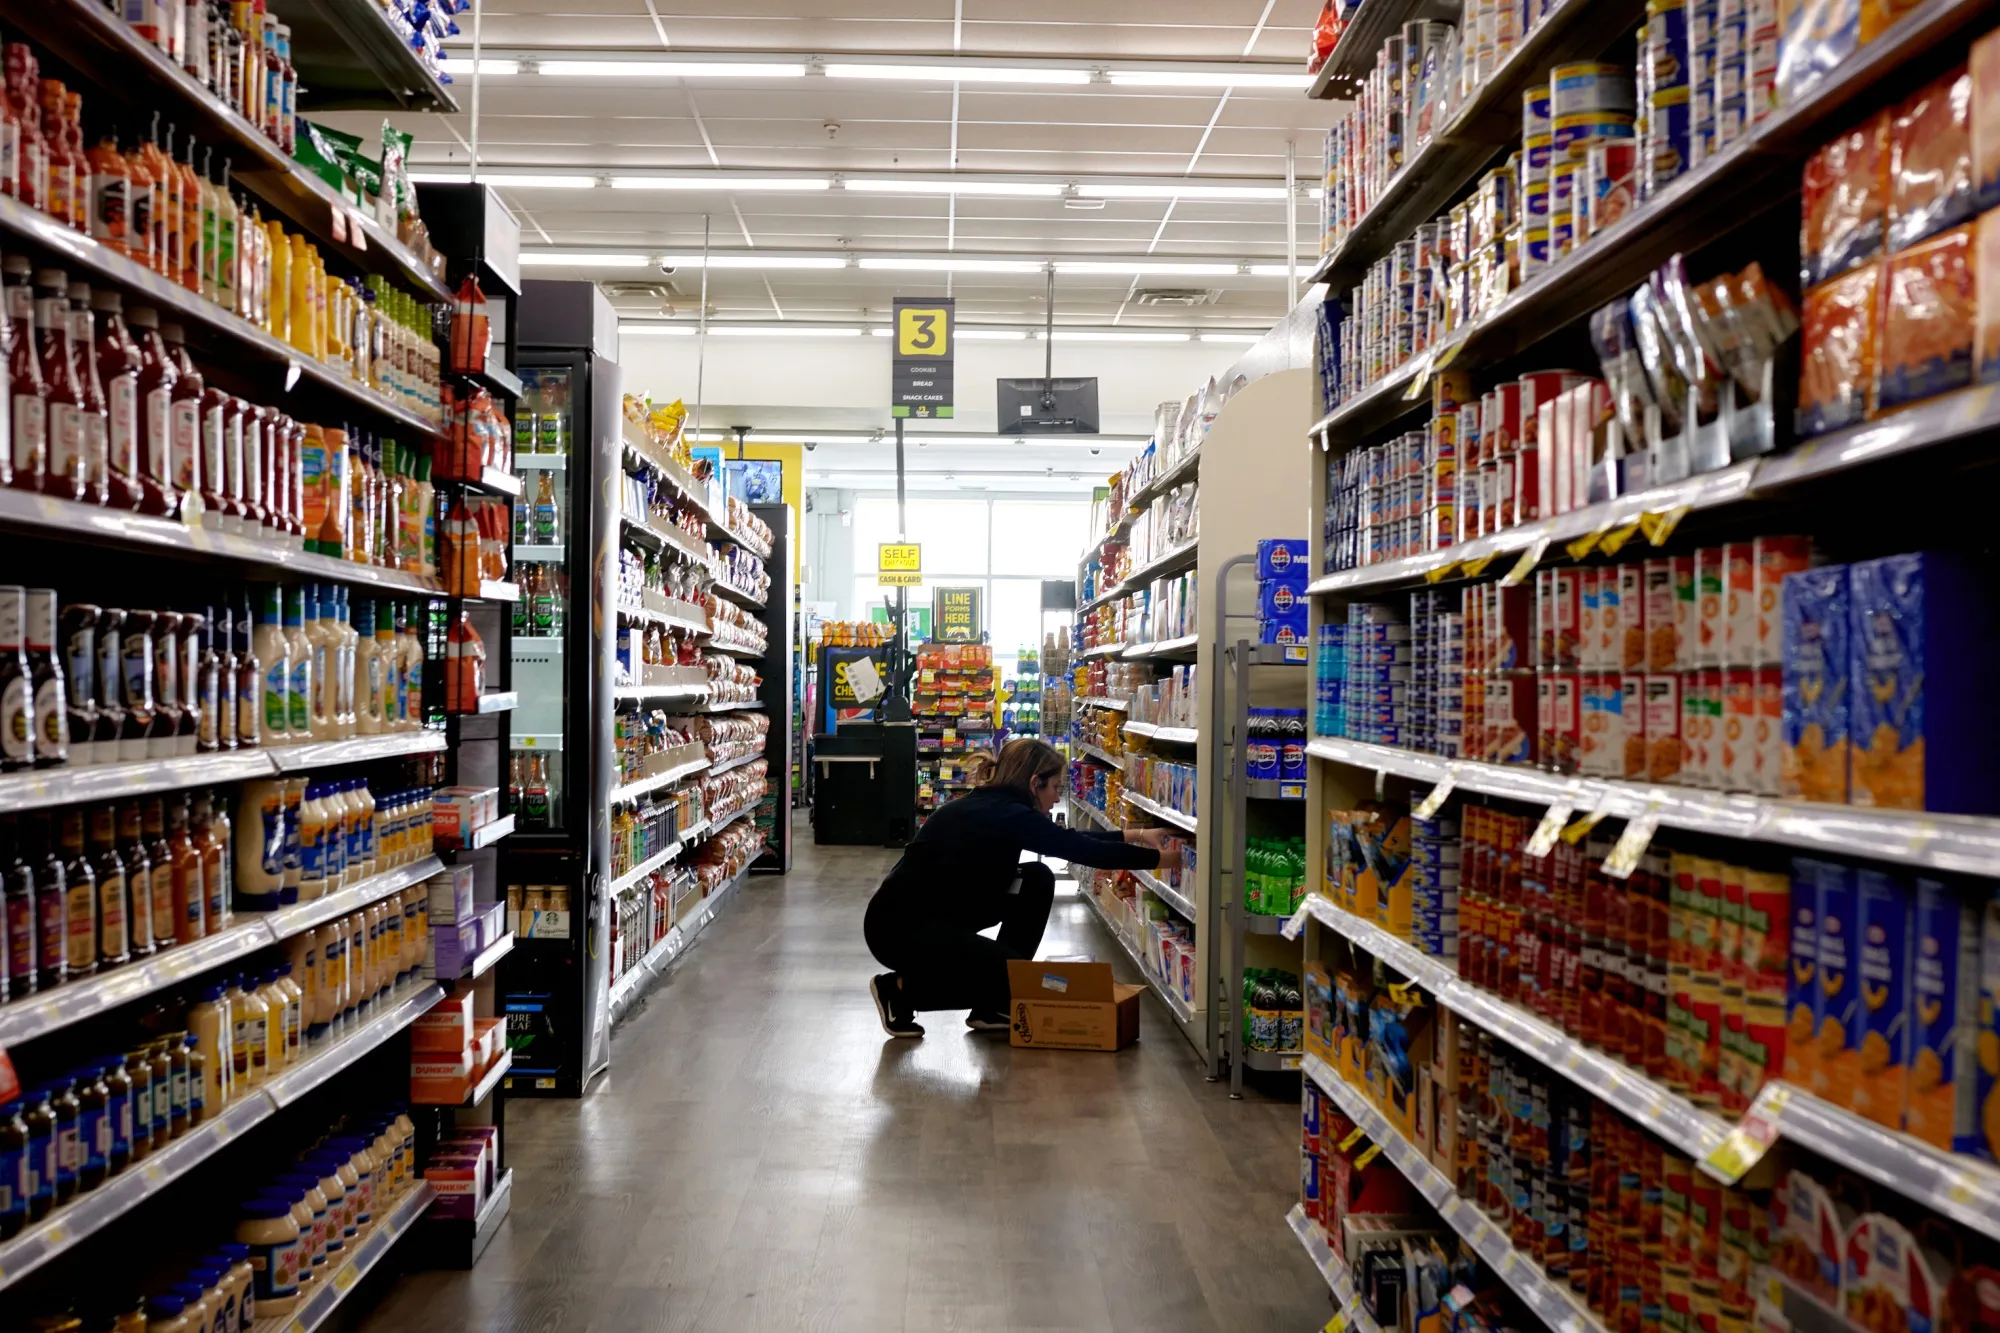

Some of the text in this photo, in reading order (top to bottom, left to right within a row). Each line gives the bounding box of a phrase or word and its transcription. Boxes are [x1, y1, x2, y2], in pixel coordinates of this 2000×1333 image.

[911, 315, 936, 349] 3
[884, 549, 915, 559] SELF
[945, 593, 970, 604] LINE
[945, 613, 970, 623] HERE
[835, 662, 887, 684] SF
[506, 1013, 531, 1022] PURE
[415, 1066, 456, 1074] DUNKIN'
